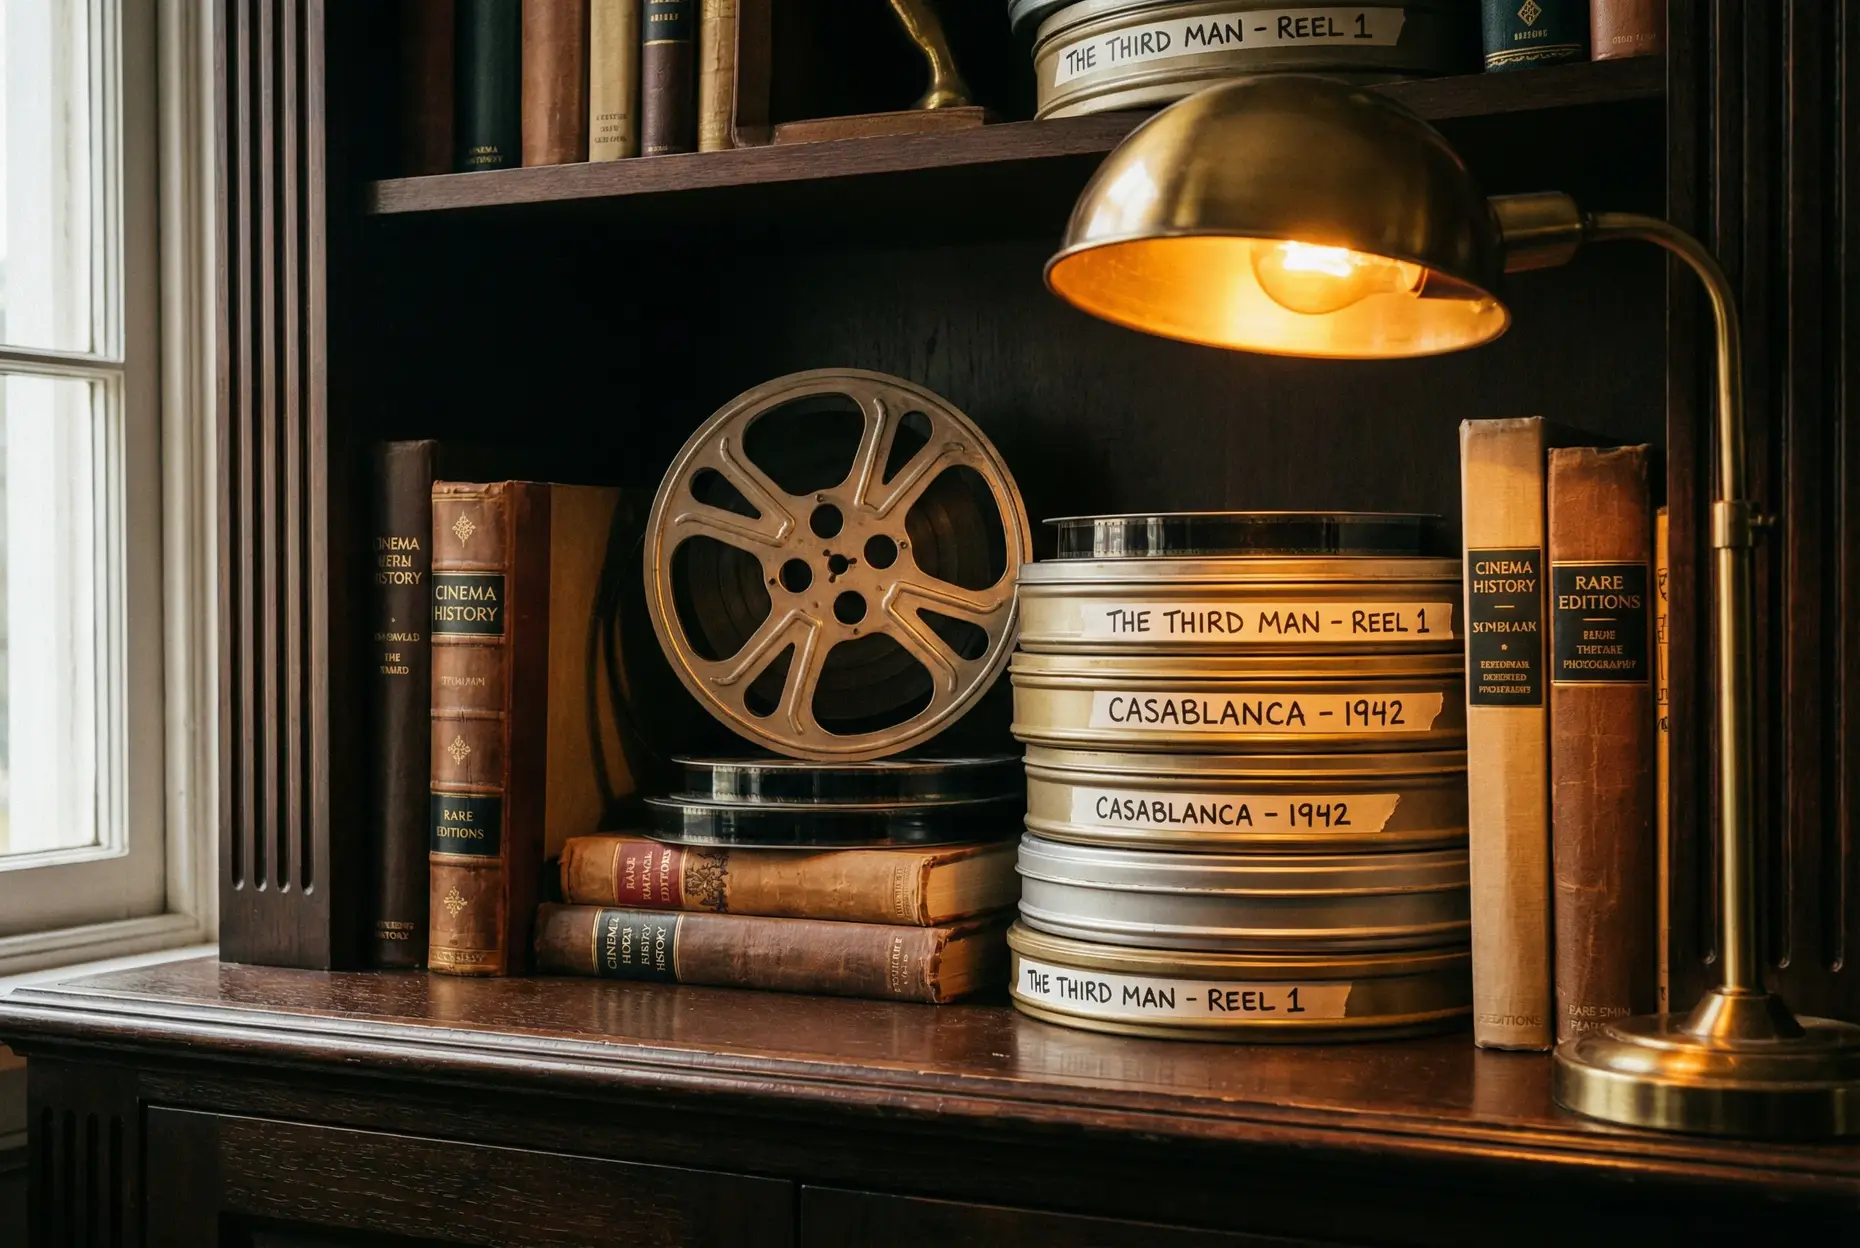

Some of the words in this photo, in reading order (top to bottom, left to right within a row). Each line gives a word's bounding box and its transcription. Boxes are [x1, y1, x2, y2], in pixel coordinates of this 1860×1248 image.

[1066, 45, 1096, 75] THE
[1106, 30, 1171, 61] THIRD
[1185, 19, 1243, 47] MAN
[1278, 15, 1344, 39] REEL
[1354, 13, 1373, 38] 1
[1476, 561, 1533, 574] CINEMA
[1473, 579, 1536, 593] HISTORY
[1575, 576, 1624, 590] RARE
[435, 585, 497, 600] CINEMA
[1558, 595, 1641, 610] EDITIONS
[434, 605, 498, 621] HISTORY
[1106, 609, 1151, 633] THE
[1163, 610, 1244, 634] THIRD
[1258, 611, 1320, 634] MAN
[1352, 611, 1408, 633] REEL
[1417, 609, 1430, 634] 1
[1108, 697, 1306, 727] CASABLANCA
[1345, 700, 1405, 726] 1942
[444, 809, 474, 821] RARE
[1096, 796, 1253, 827] CASABLANCA
[1289, 802, 1351, 827] 1942
[436, 825, 484, 839] EDITIONS
[1027, 969, 1050, 994] THE
[1056, 976, 1112, 1003] THIRD
[1123, 985, 1175, 1009] MAN
[1208, 988, 1276, 1012] REEL
[1286, 987, 1305, 1012] 1
